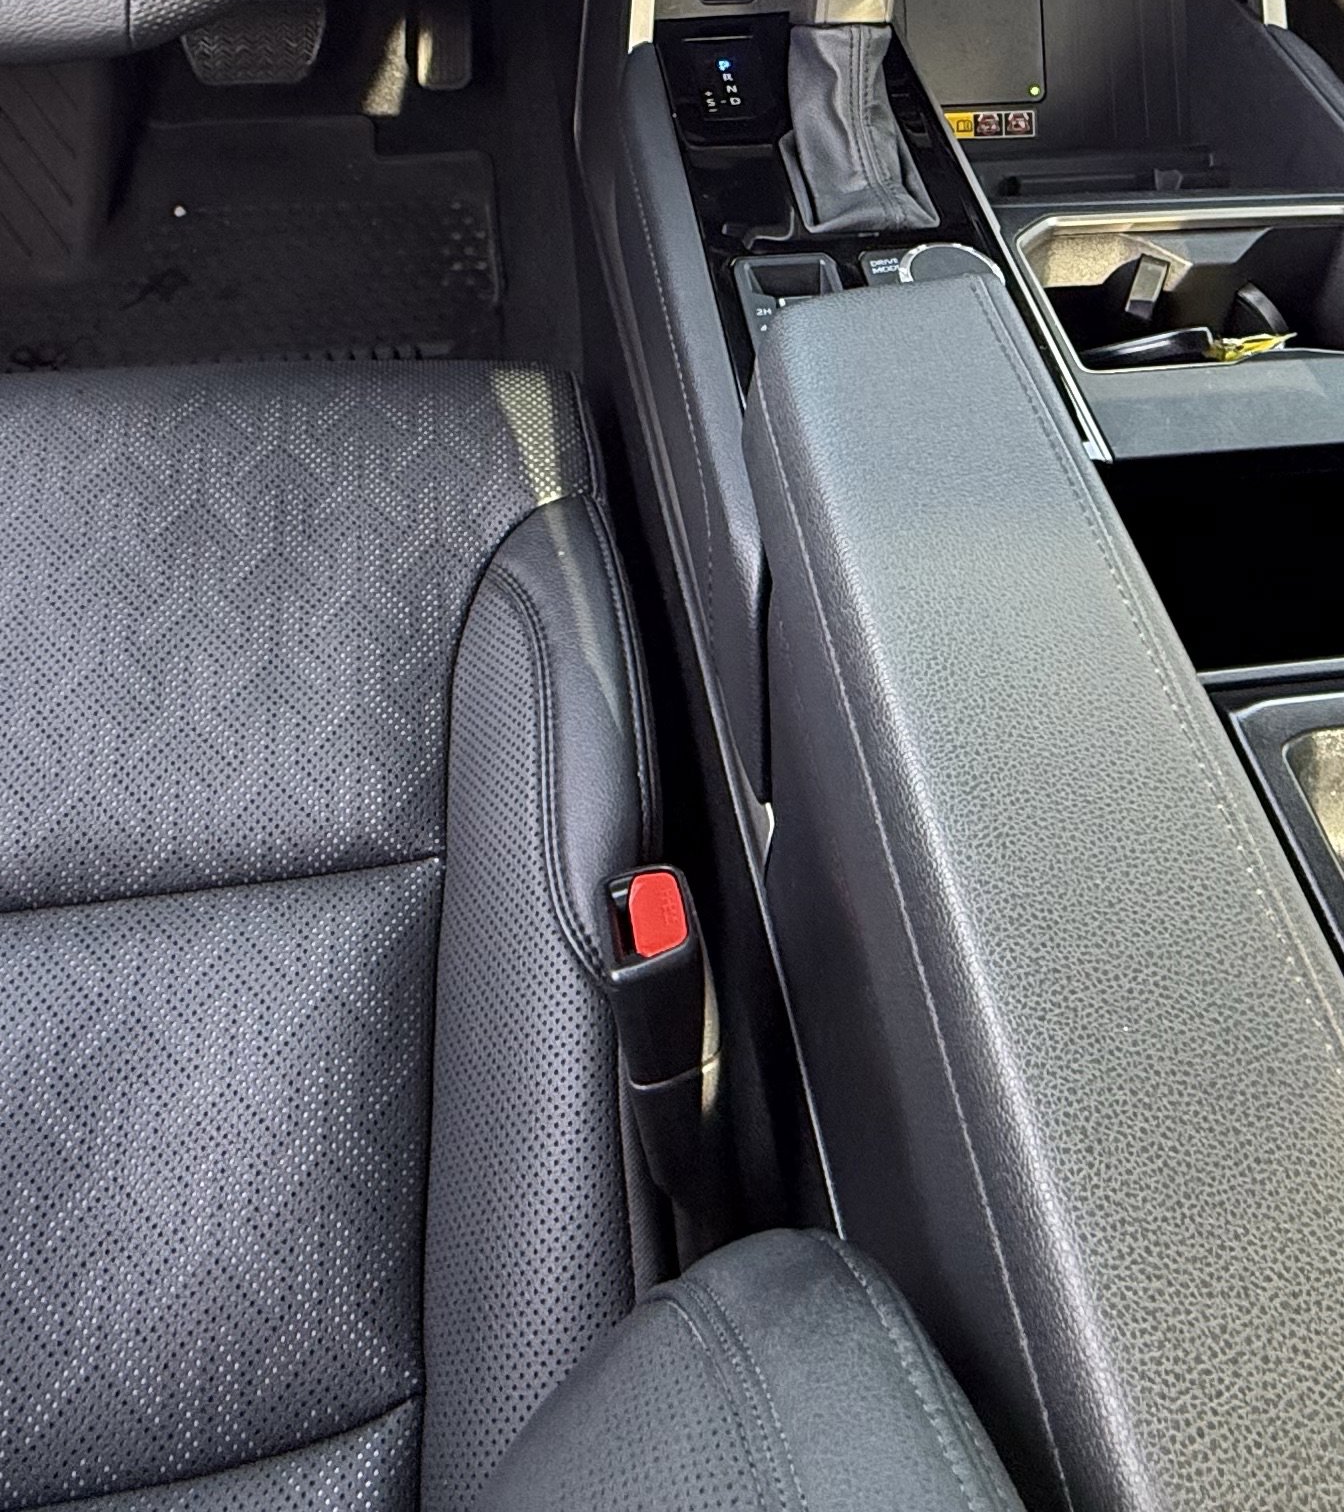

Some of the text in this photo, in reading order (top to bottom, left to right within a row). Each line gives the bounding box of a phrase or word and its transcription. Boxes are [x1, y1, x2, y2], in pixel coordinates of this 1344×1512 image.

[726, 84, 738, 94] N
[729, 97, 742, 106] D
[756, 307, 773, 317] 2H
